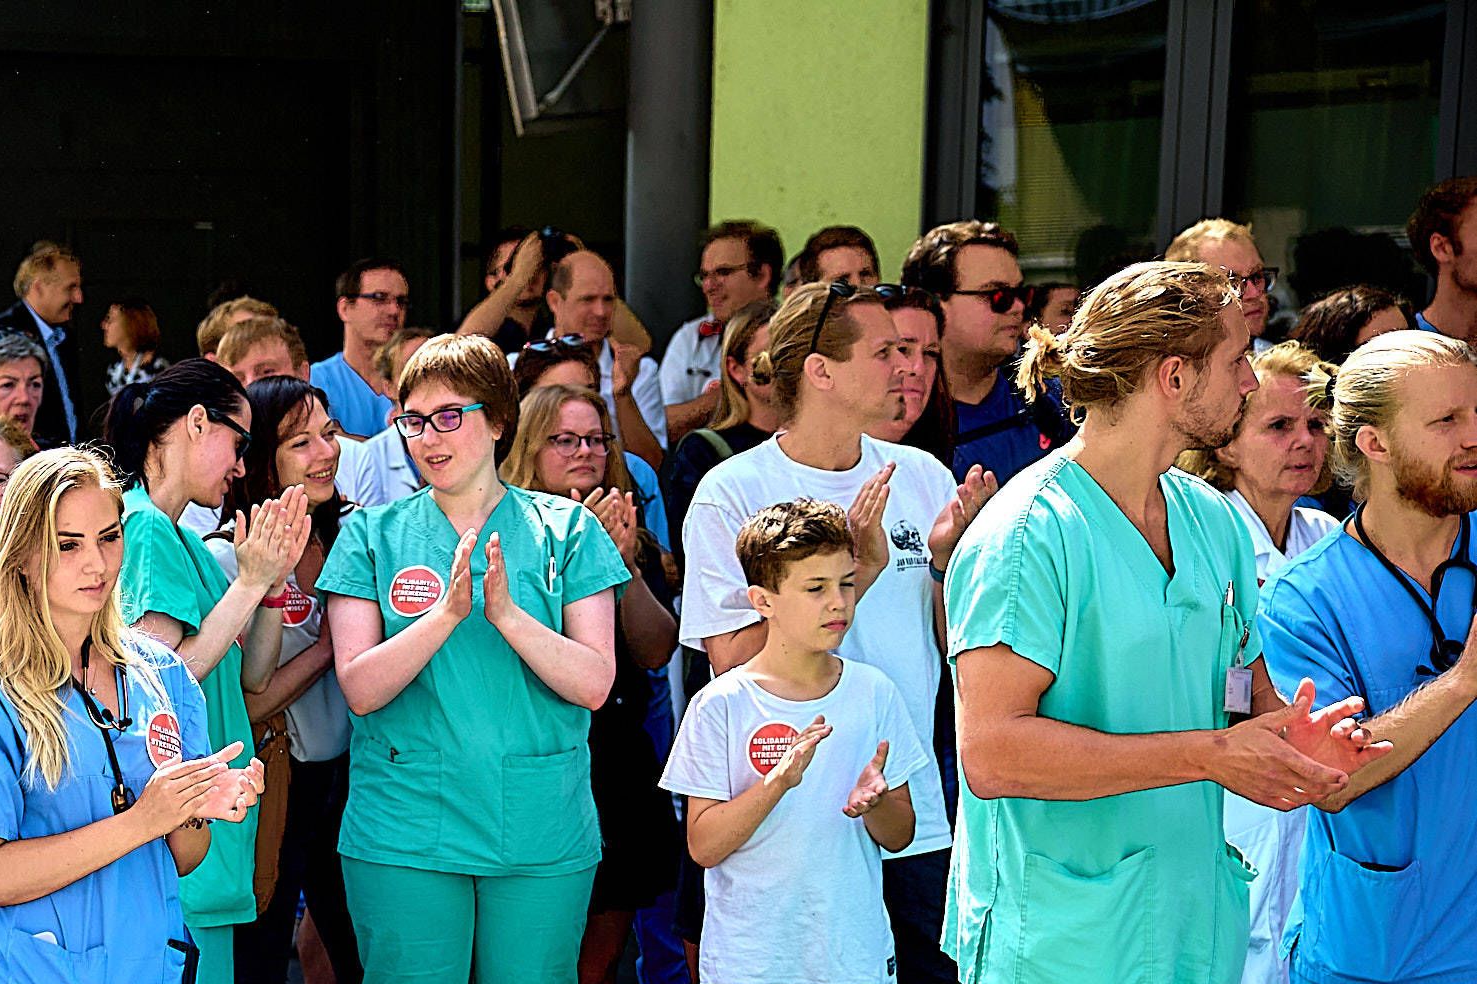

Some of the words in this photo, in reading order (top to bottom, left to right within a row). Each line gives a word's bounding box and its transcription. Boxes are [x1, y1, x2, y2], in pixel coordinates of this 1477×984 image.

[396, 578, 439, 587] SOLIDARITÄT
[393, 590, 437, 599] STREIKENDEN
[753, 736, 793, 745] SOLIDARIT
